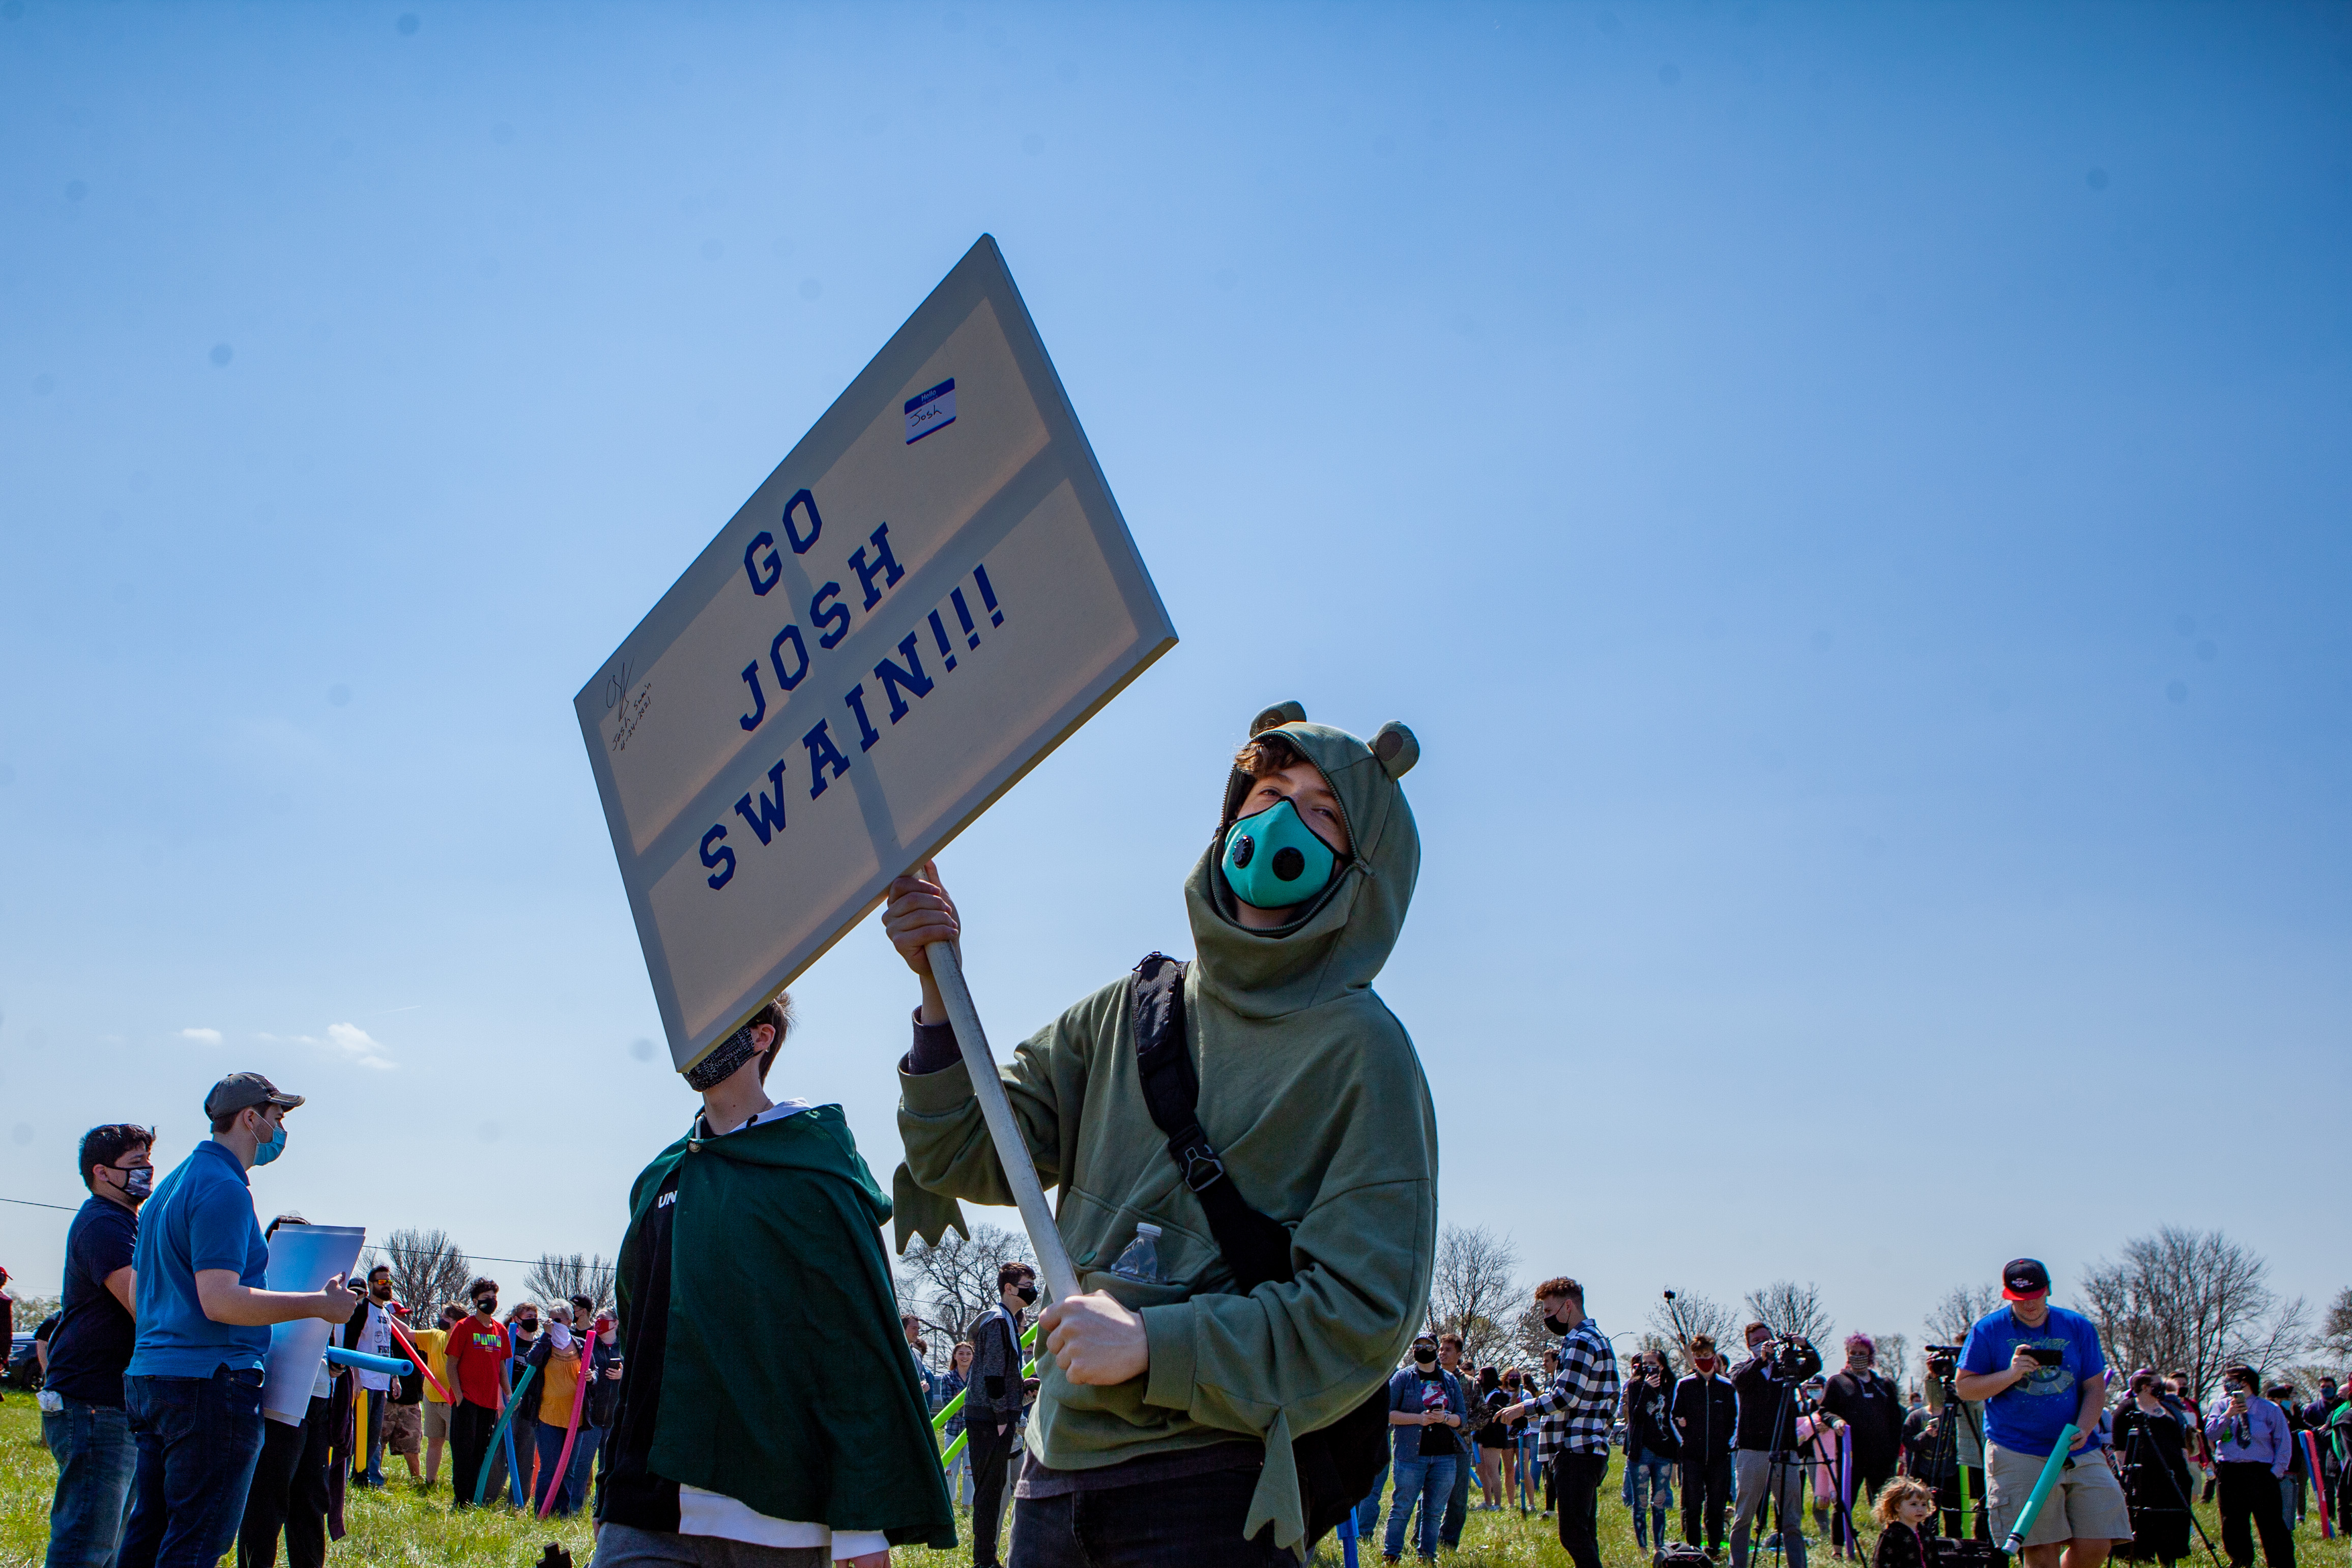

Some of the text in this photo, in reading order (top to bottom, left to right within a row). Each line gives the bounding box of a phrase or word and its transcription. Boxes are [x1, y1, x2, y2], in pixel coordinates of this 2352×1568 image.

[910, 404, 942, 427] Josh
[744, 489, 822, 595] GO
[740, 521, 904, 730] JOSH
[613, 717, 631, 751] Josh
[700, 564, 1004, 889] SWAIN!!!
[714, 1047, 741, 1068] MYKONOS
[658, 1190, 678, 1208] UN
[473, 1333, 501, 1348] PUMA
